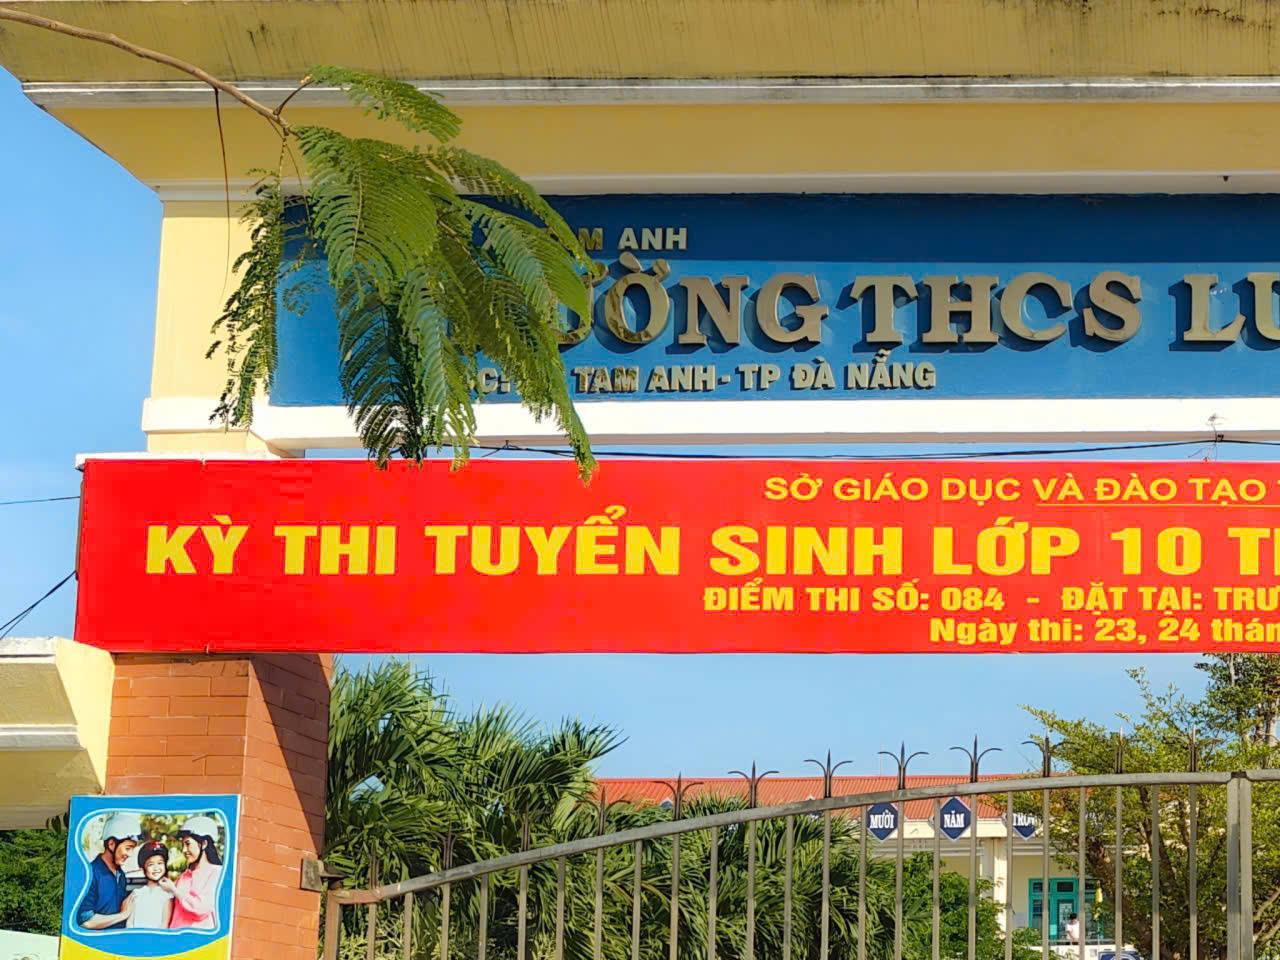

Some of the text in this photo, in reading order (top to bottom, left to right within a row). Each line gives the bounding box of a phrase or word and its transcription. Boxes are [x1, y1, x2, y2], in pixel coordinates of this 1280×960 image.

[617, 226, 688, 250] ANH
[850, 270, 1144, 344] THCS
[573, 365, 640, 393] TAM
[738, 364, 780, 391] TP
[791, 356, 835, 389] ĐÀ
[846, 348, 937, 389] NẴNG
[767, 474, 822, 500] SỞ
[834, 474, 928, 500] GIÁO
[942, 479, 1019, 505] DỤC
[1034, 475, 1083, 500] VÀ
[1096, 474, 1177, 500] ĐÀO
[1189, 479, 1265, 505] TẠO
[147, 516, 247, 573] KỲ
[275, 527, 395, 574] THI
[425, 506, 679, 574] TUYỂN
[711, 526, 901, 575] SINH
[934, 517, 1079, 575] LỚP
[1111, 528, 1201, 575] 10
[704, 578, 793, 610] ĐIỂM
[806, 588, 858, 611] THI
[873, 583, 928, 610] SỐ:
[942, 588, 1004, 610] 084
[1062, 583, 1127, 615] ĐẶT
[1139, 587, 1201, 614] TẠI:
[931, 619, 1016, 645] Ngày
[1028, 619, 1082, 641] thi:
[1095, 618, 1146, 643] 23,
[1158, 619, 1200, 640] 24
[870, 809, 895, 829] MƯỜI
